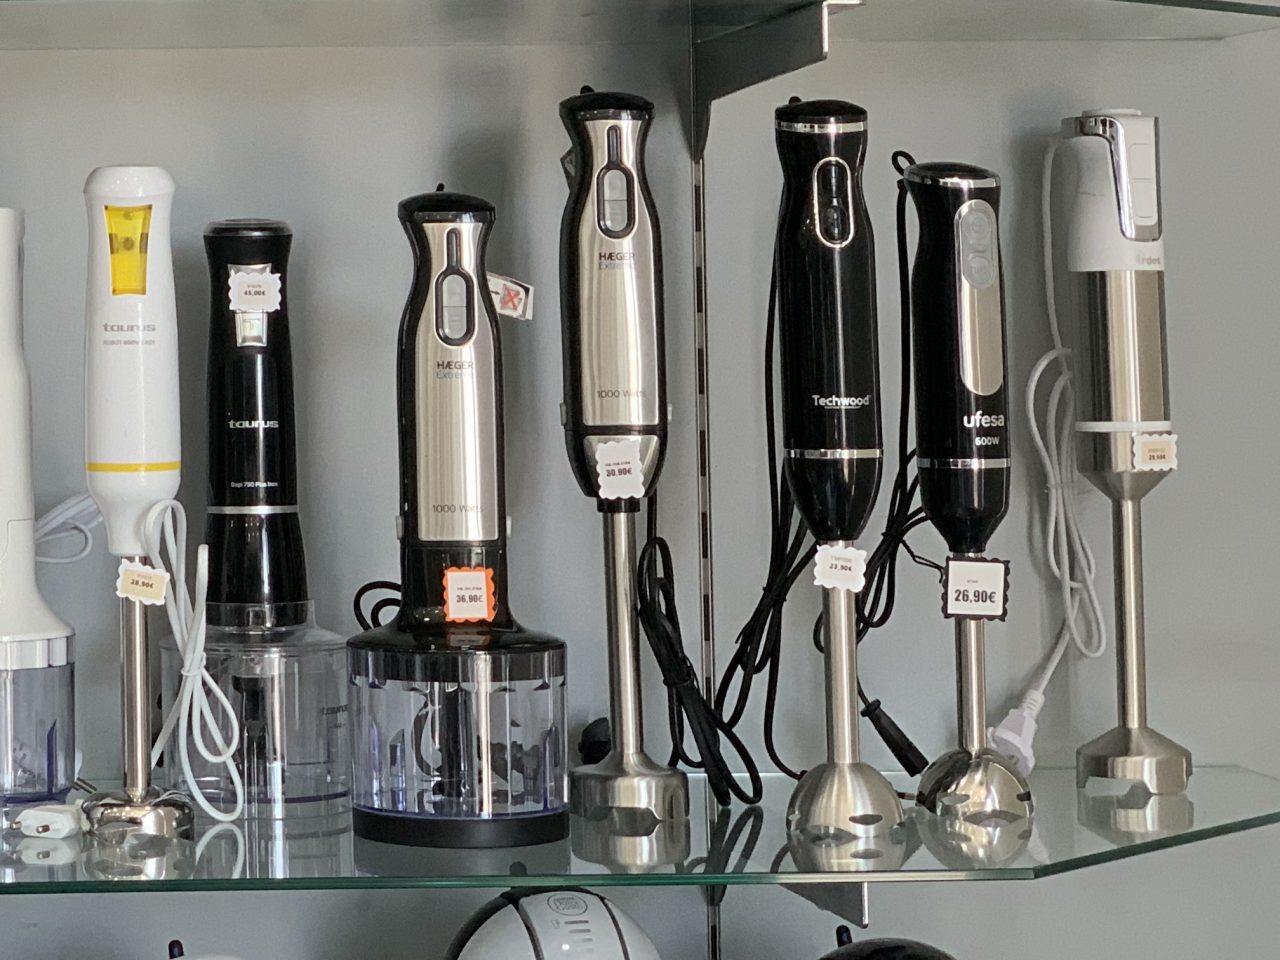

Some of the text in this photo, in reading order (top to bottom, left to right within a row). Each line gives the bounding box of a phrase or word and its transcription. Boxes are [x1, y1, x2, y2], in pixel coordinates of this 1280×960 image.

[102, 322, 156, 332] taurus
[597, 390, 620, 398] 1000
[811, 394, 870, 406] Techwood
[963, 410, 1005, 428] ufesa
[228, 420, 279, 429] taurus
[975, 436, 1000, 446] 600W
[432, 504, 457, 513] 1000
[456, 595, 484, 604] 36,90€
[954, 589, 996, 603] 26,90€
